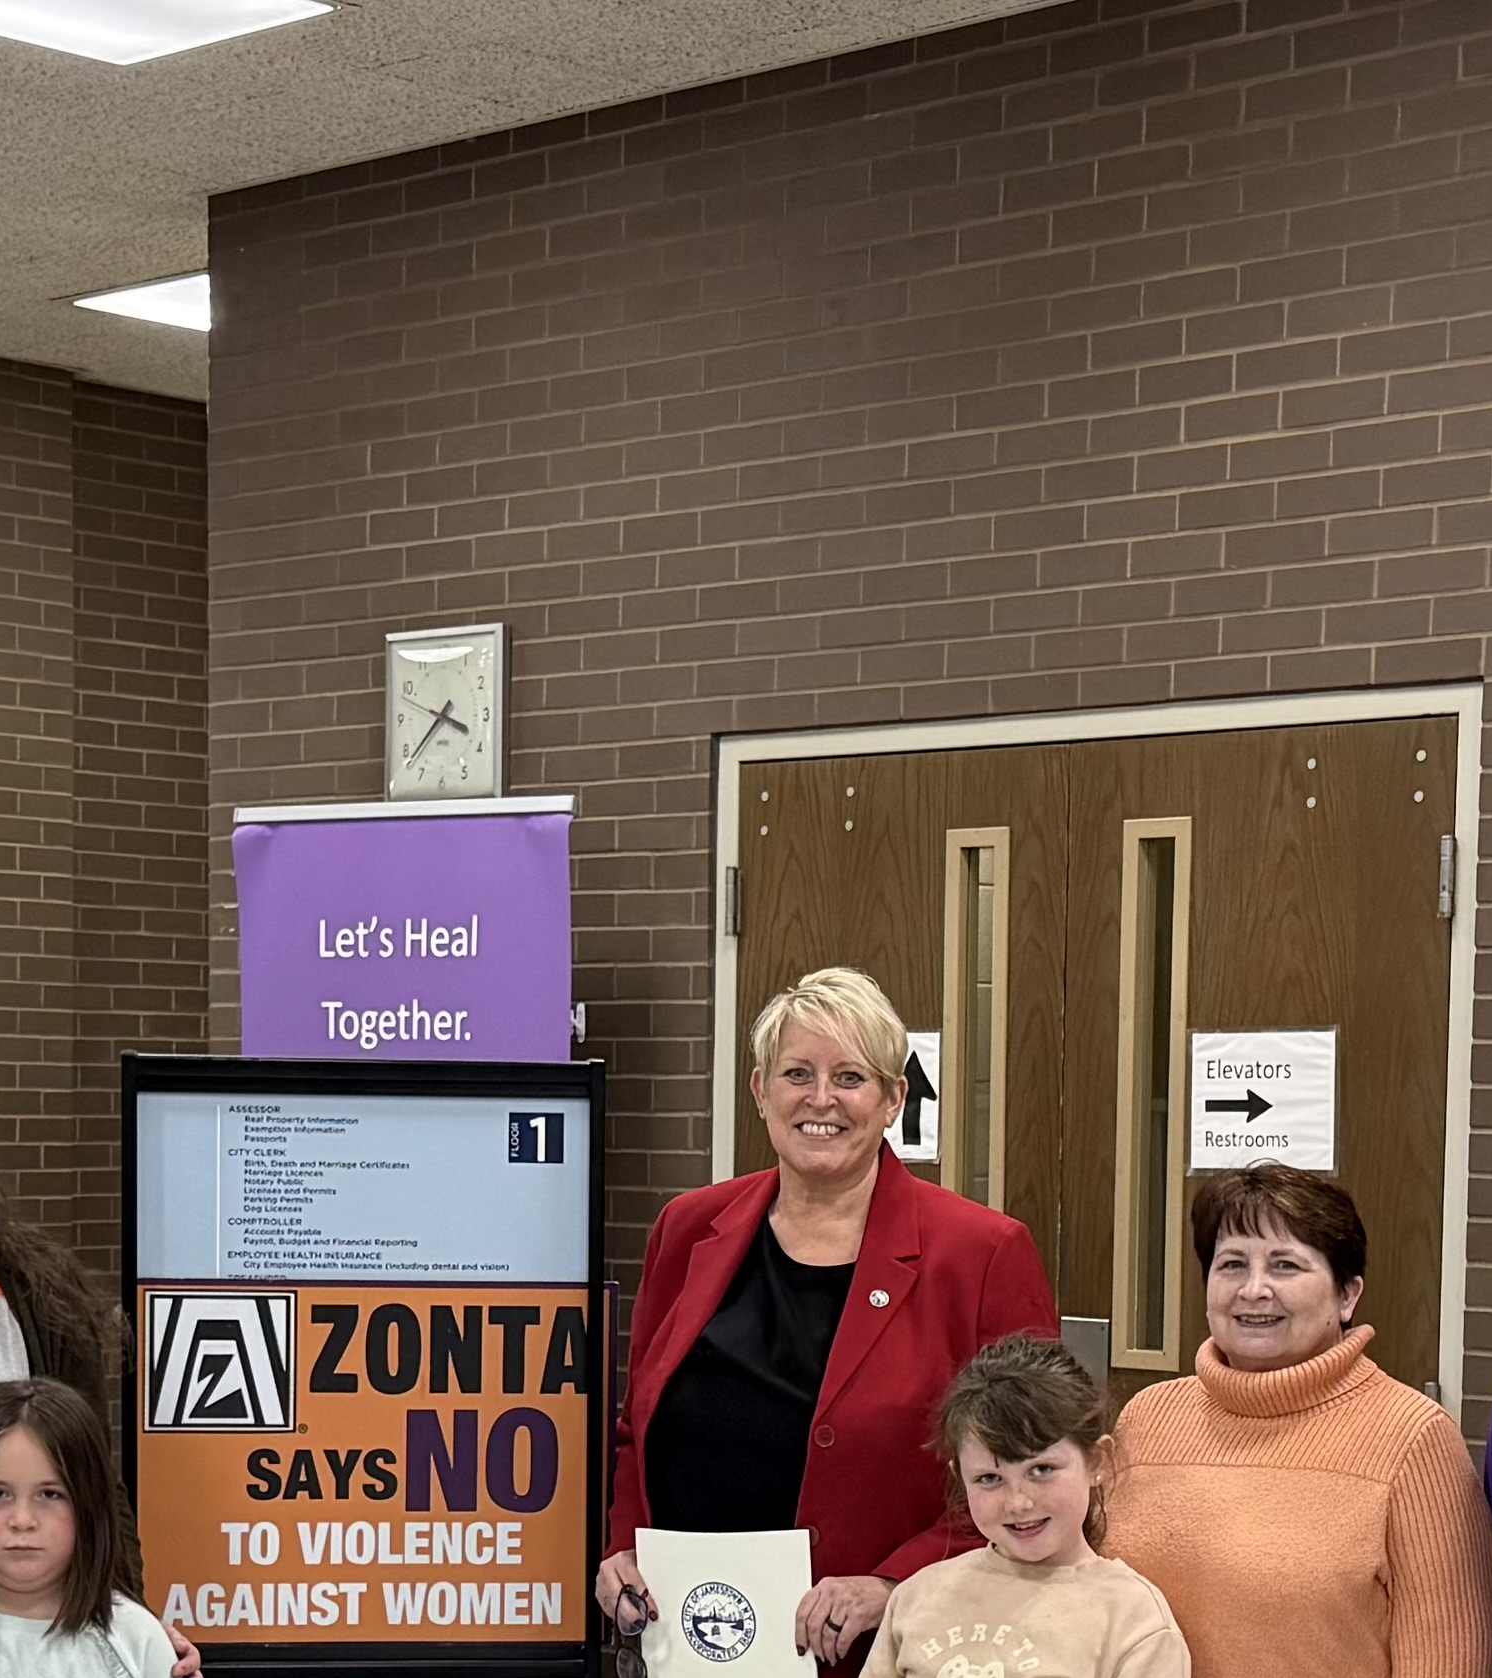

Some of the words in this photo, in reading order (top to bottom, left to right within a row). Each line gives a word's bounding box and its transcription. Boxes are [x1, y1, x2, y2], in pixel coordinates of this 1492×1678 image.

[402, 681, 413, 695] 10
[477, 675, 485, 690] 2
[397, 713, 404, 728] 9
[483, 707, 490, 722] 3
[403, 743, 409, 758] 8
[418, 767, 425, 782] 7
[461, 765, 468, 780] 5
[439, 775, 445, 790] 6
[404, 914, 479, 957] Heal
[321, 999, 472, 1050] Together.
[1205, 1059, 1292, 1081] Elevators
[228, 1105, 281, 1114] ASSESSOR
[510, 1122, 520, 1157] FLOOR
[529, 1116, 546, 1163] 1
[1205, 1130, 1290, 1149] Restrooms
[228, 1148, 251, 1157] CITY
[253, 1149, 287, 1157] CLERK
[227, 1218, 302, 1226] COMPTROLLER
[227, 1251, 280, 1260] EMPLOYEE
[283, 1251, 322, 1260] HEALTH
[309, 1303, 588, 1396] ZONTA
[245, 1448, 398, 1501] SAYS
[404, 1406, 560, 1514] NO
[220, 1521, 281, 1565] TO
[297, 1521, 523, 1565] VIOLENCE
[160, 1583, 368, 1627] AGAINST
[382, 1582, 563, 1627] WOMEN
